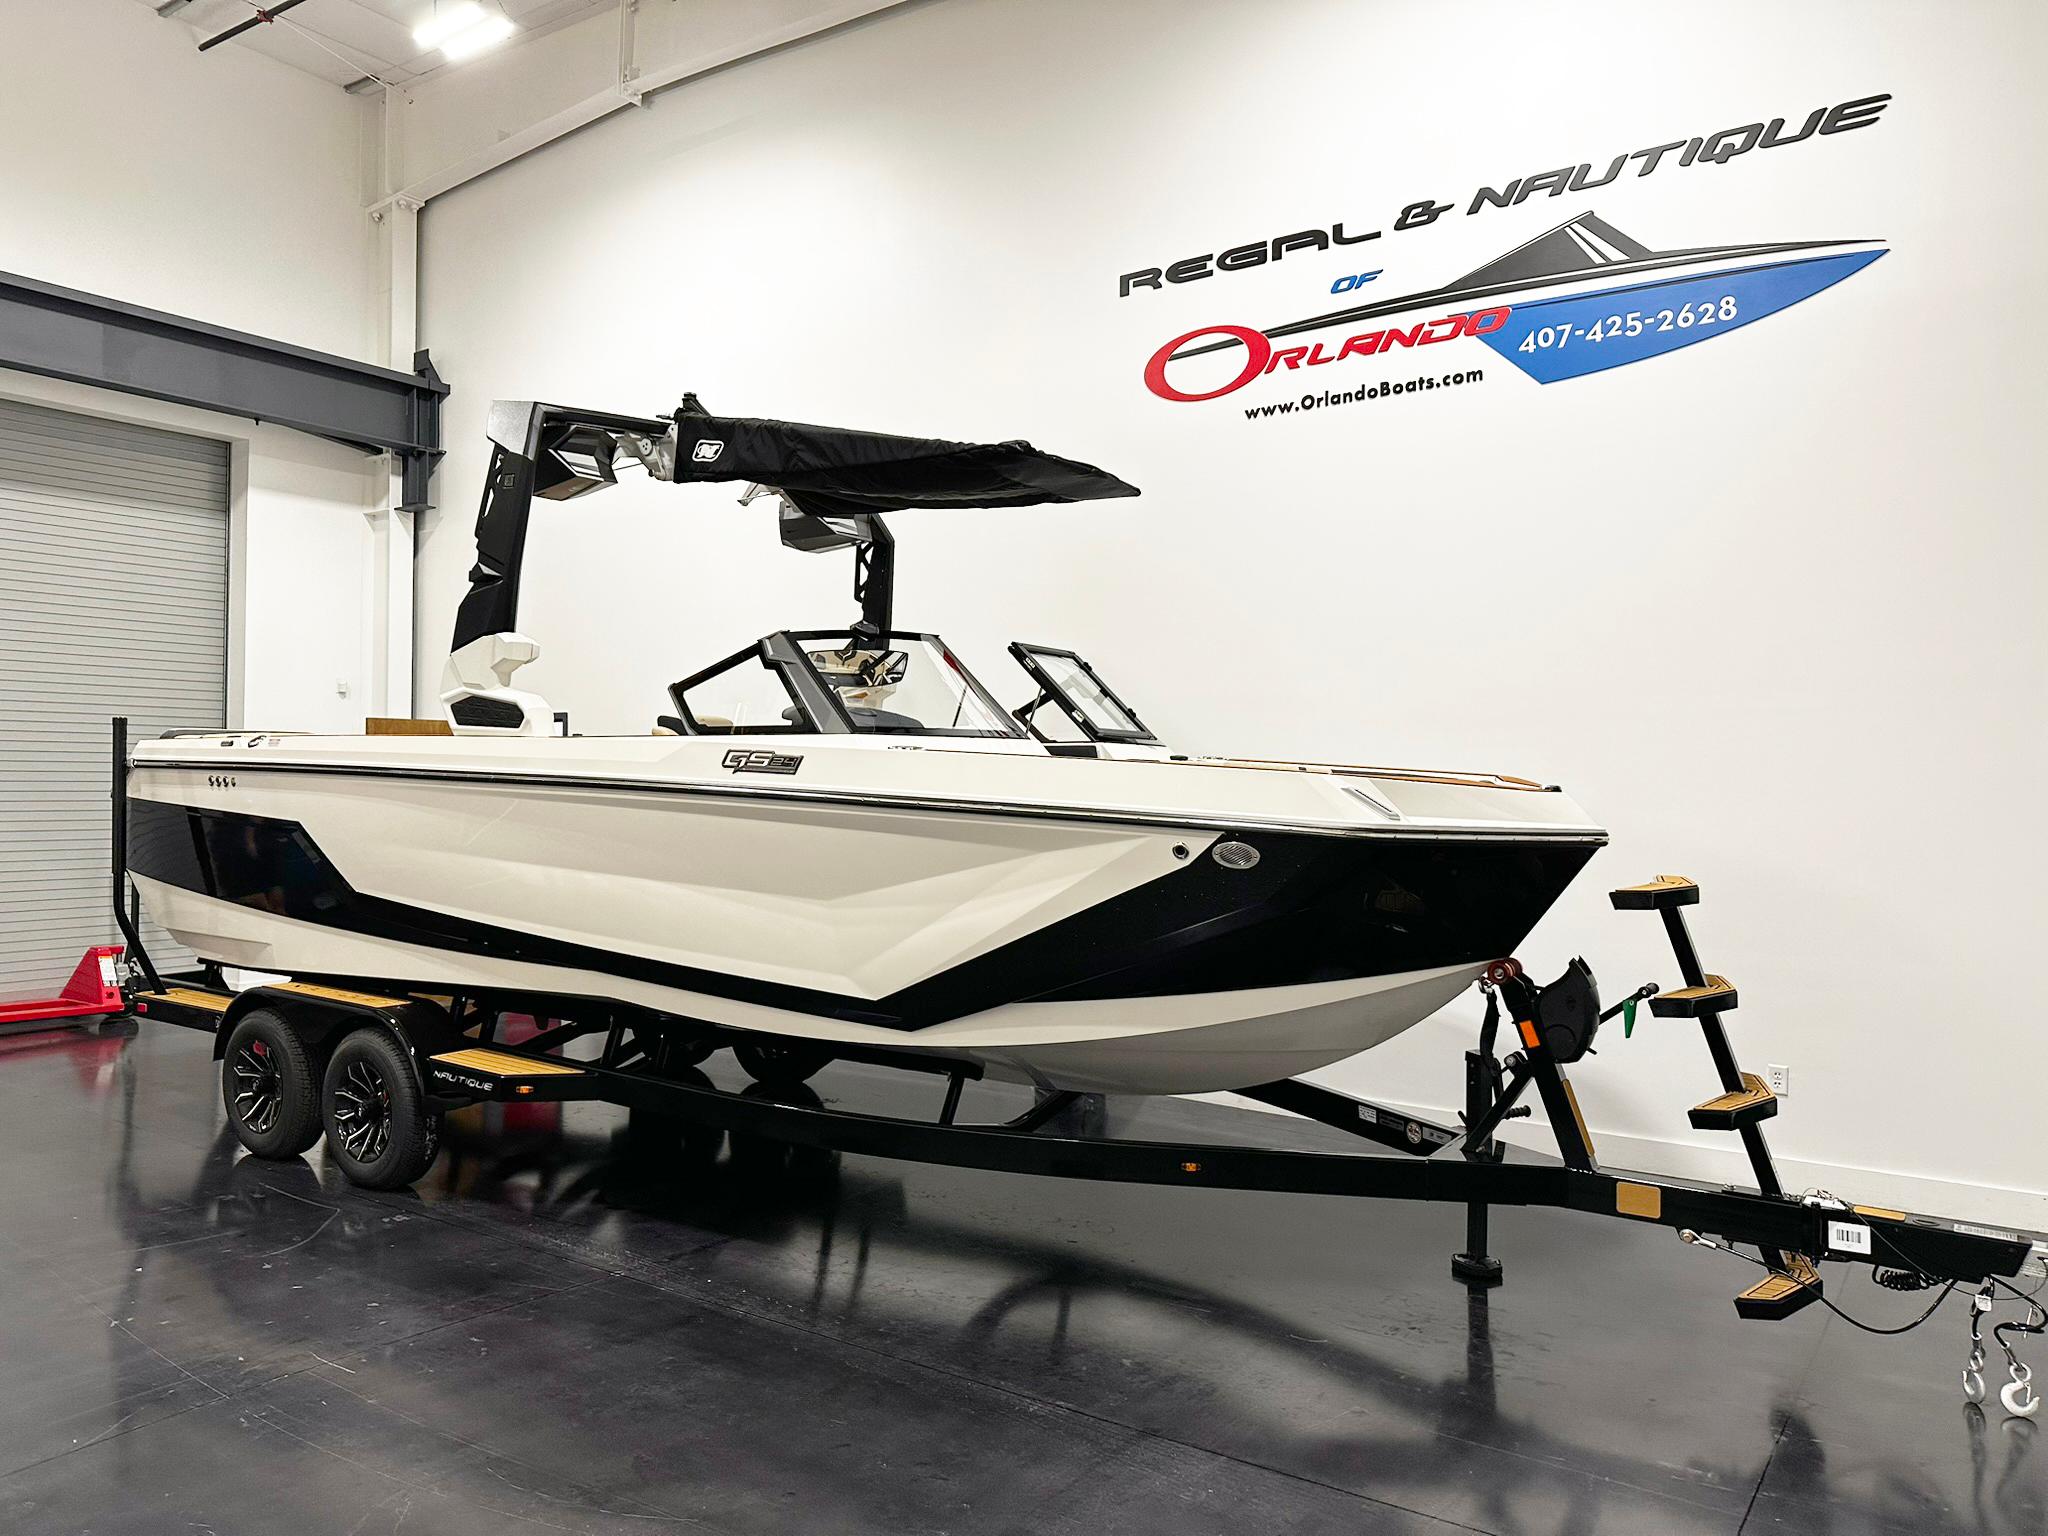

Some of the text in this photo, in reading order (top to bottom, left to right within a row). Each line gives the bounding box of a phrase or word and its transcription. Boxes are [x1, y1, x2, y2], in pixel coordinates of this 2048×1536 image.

[1119, 93, 1893, 297] REGAL & NAUTIQUE
[1329, 268, 1383, 294] OF
[1517, 294, 1739, 355] 407-425-2628
[1244, 367, 1484, 420] www.OrlandoBoats.com
[433, 1070, 494, 1092] NAUTIQUE
